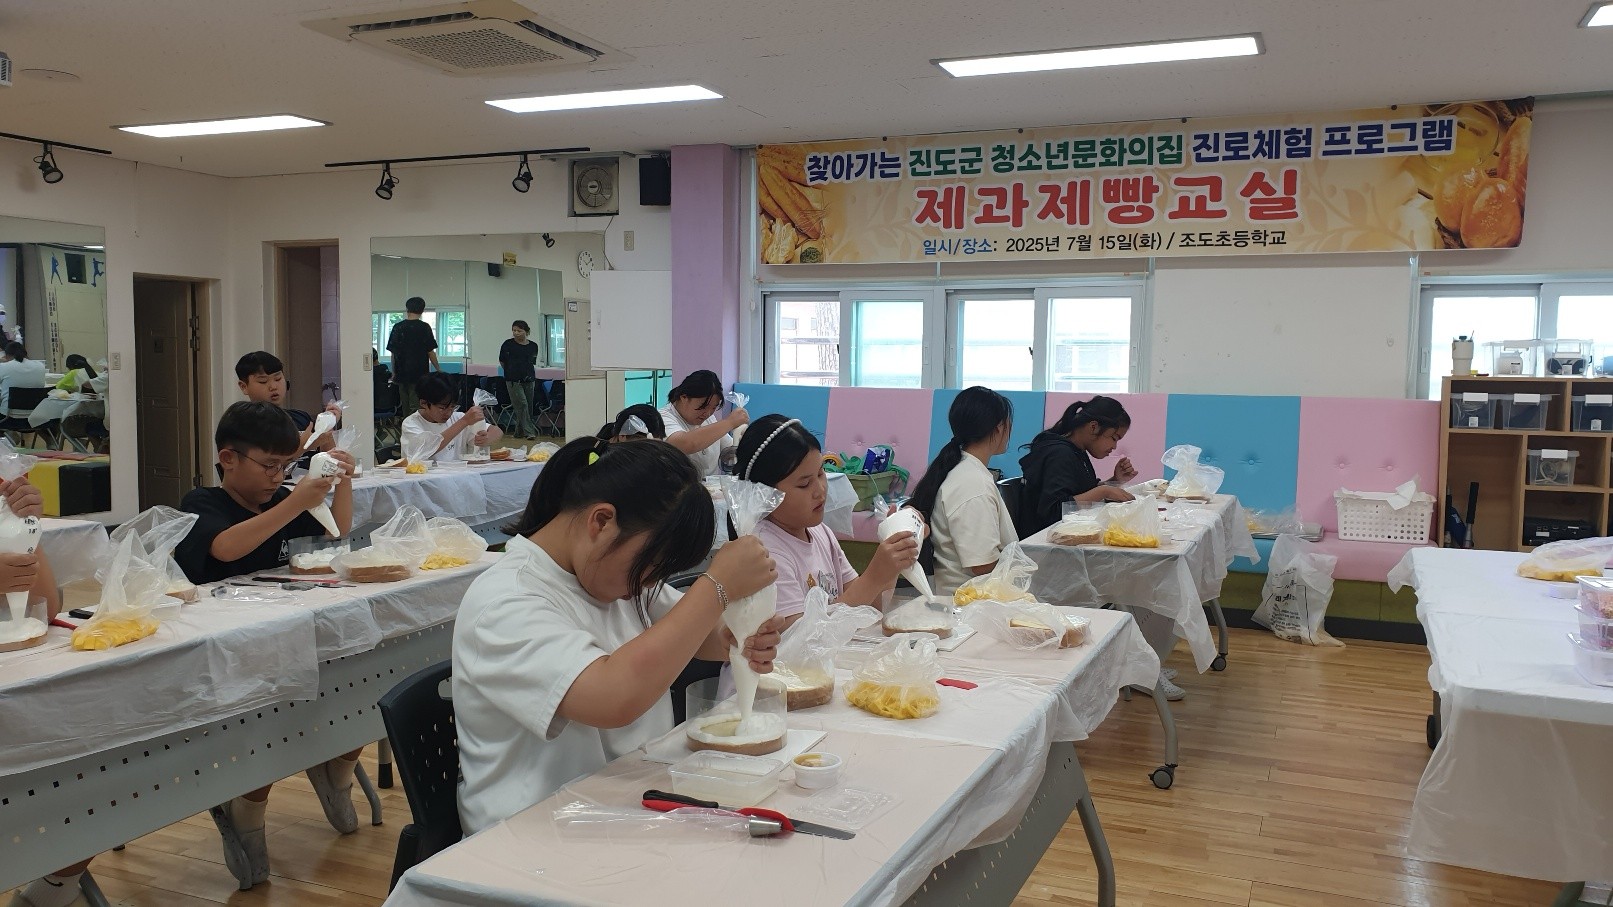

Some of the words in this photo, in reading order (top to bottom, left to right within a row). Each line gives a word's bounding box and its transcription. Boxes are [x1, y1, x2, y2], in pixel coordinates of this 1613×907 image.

[807, 151, 902, 182] 찾아가는
[908, 146, 983, 176] 진도군
[990, 134, 1183, 174] 청소년문화의집
[1192, 127, 1313, 162] 진로체험
[1321, 118, 1454, 157] 프로그램
[914, 169, 1299, 230] 제과제빵교실
[923, 238, 997, 255] 일시/장소:
[1005, 235, 1060, 252] 2025년
[1066, 234, 1092, 252] 7월
[1098, 232, 1163, 251] 15일(화)
[1165, 232, 1176, 250] /
[1178, 229, 1287, 248] 조도초등학교
